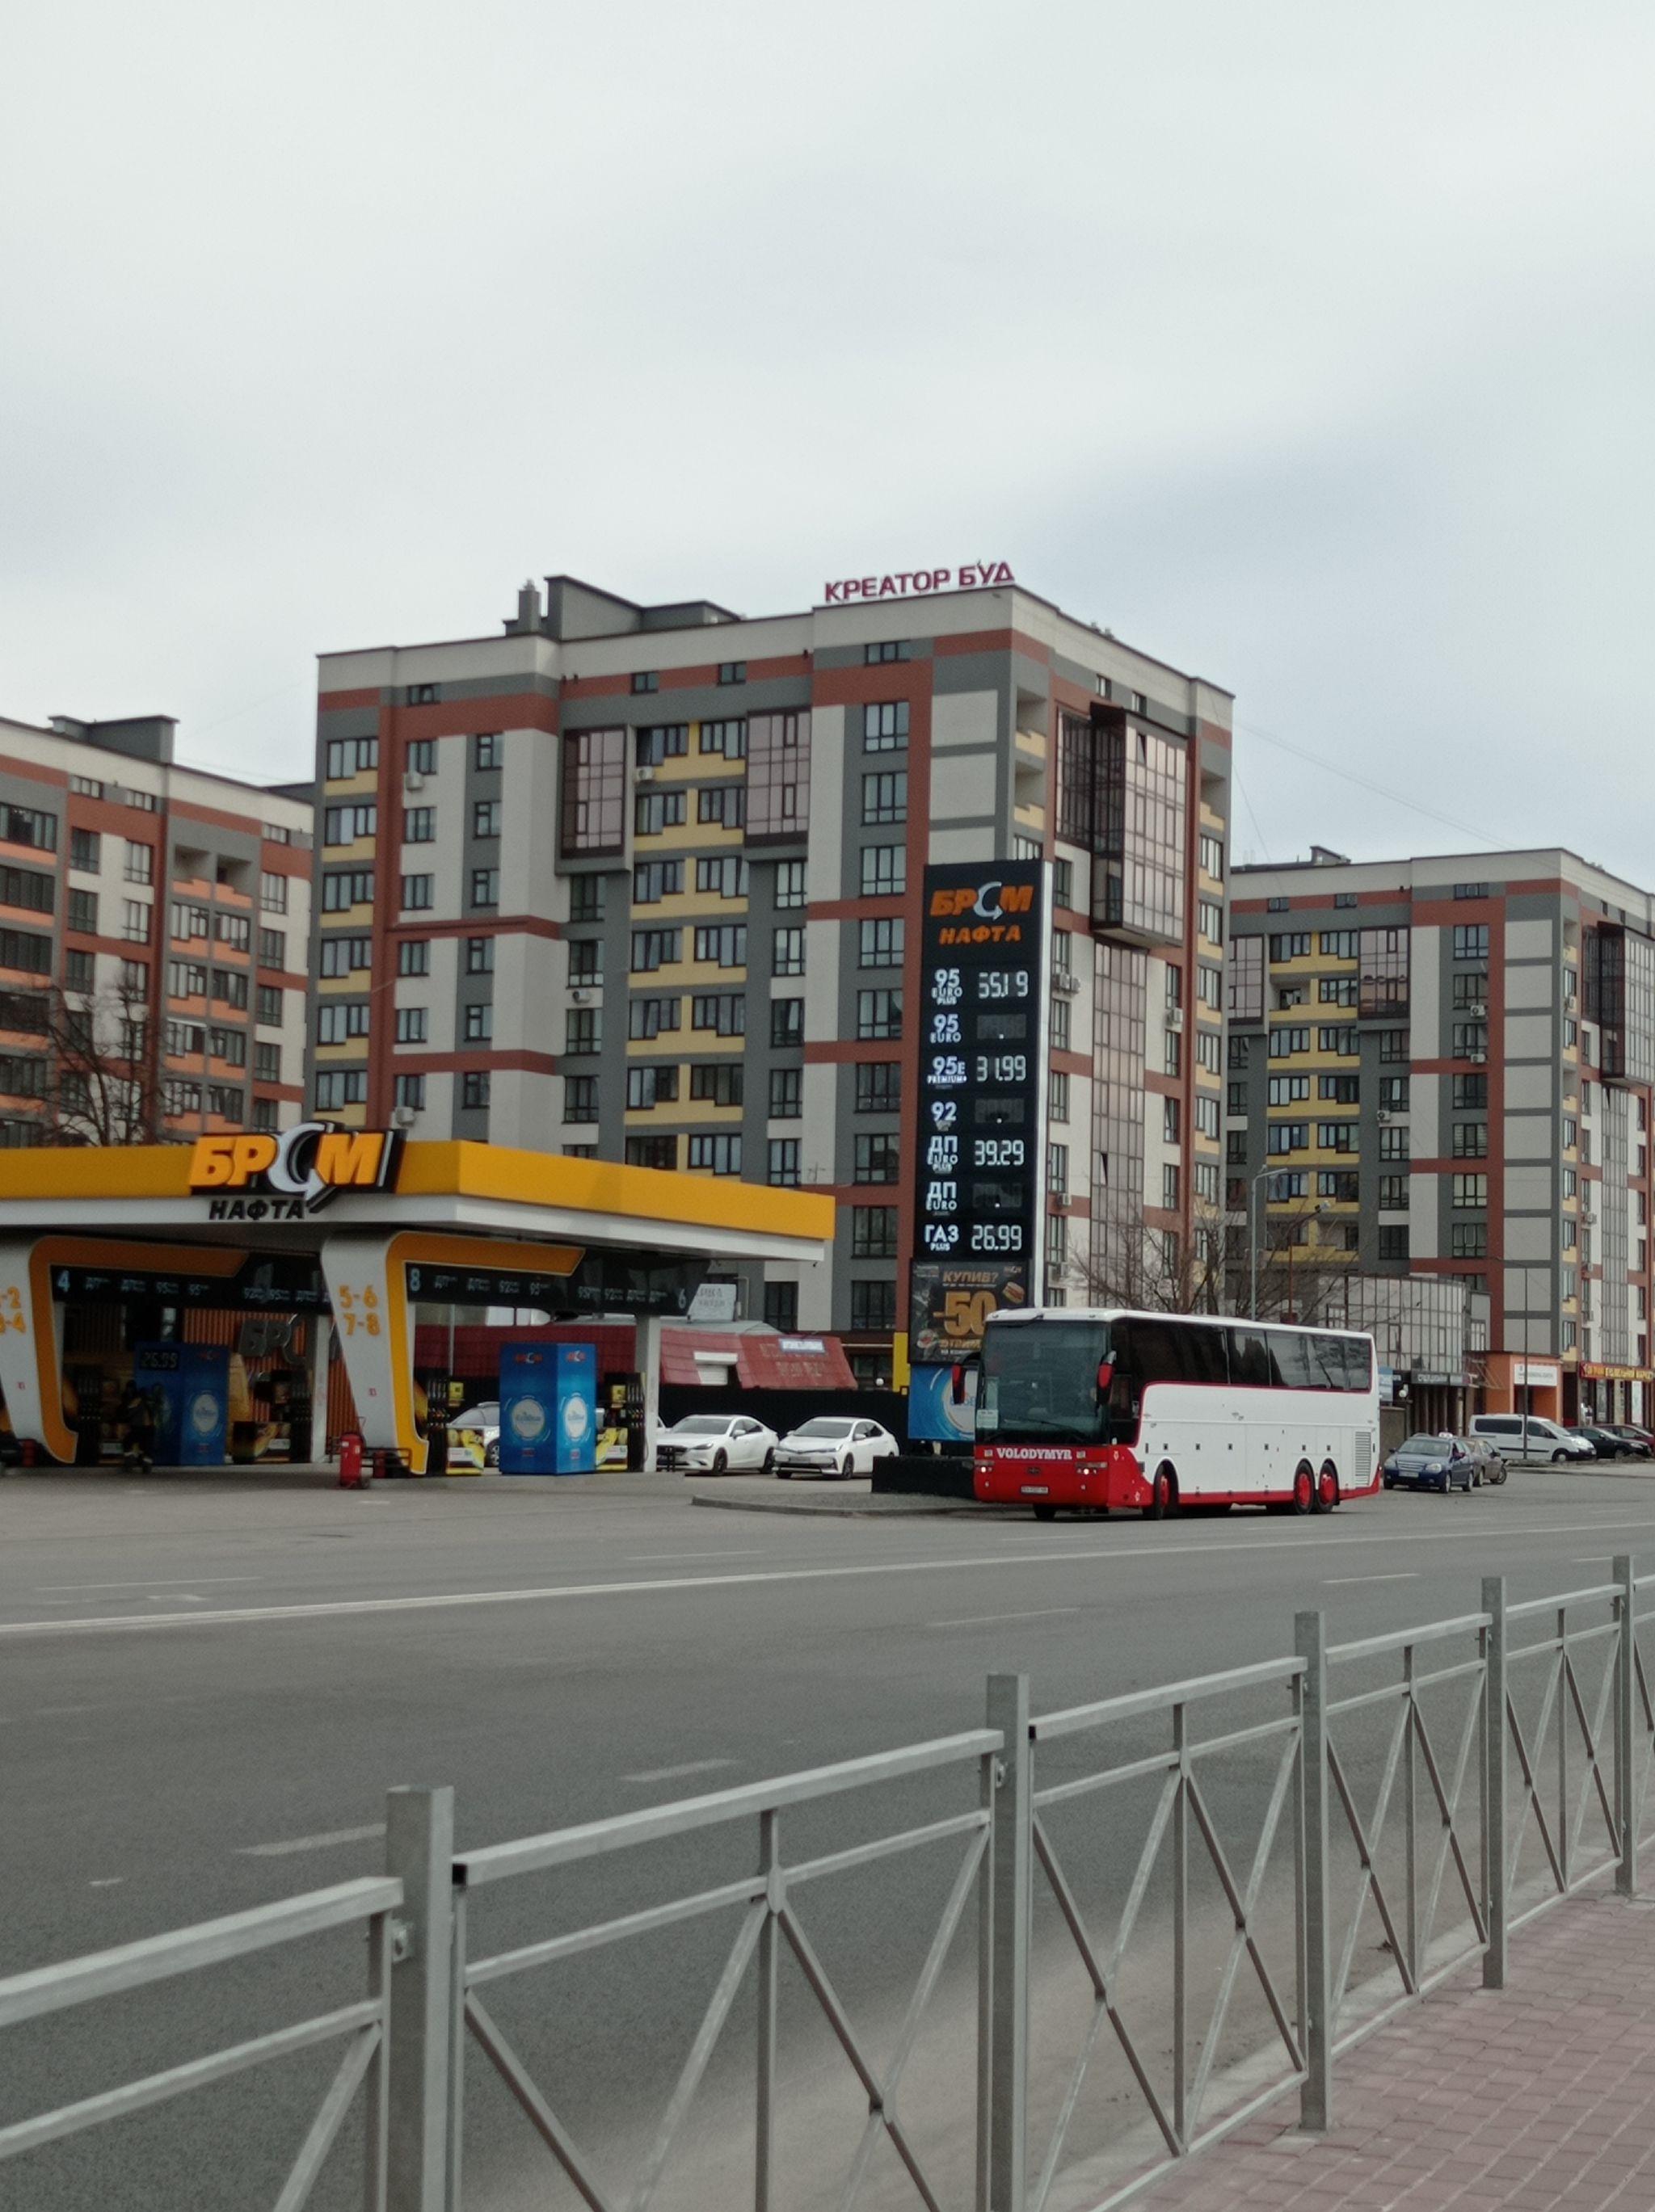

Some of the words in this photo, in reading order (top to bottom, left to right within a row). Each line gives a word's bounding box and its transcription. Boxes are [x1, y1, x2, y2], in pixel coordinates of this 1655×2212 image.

[825, 569, 950, 603] КРЕАТОР
[958, 561, 1015, 587] БУД
[931, 881, 1034, 920] БРСМ
[939, 925, 1021, 944] НАФТА
[934, 969, 960, 989] 95
[931, 987, 963, 999] EURO
[933, 1014, 959, 1034] 95
[930, 1032, 962, 1043] EURO
[976, 1055, 1026, 1082] 31.99
[931, 1102, 957, 1121] 92
[927, 1153, 958, 1166] EURO
[929, 1135, 958, 1154] ДП
[974, 1139, 1025, 1166] 39.29
[189, 1122, 387, 1201] БРСМ
[929, 1182, 957, 1201] ДП
[208, 1199, 305, 1221] НАФТА
[926, 1198, 958, 1211] EURO
[924, 1224, 959, 1243] ГАЗ
[971, 1225, 1022, 1251] 26.99
[930, 1243, 950, 1251] PLUS
[57, 1270, 70, 1293] 4
[410, 1268, 420, 1292] 8
[942, 1271, 1000, 1283] КУПИВ?
[0, 1286, 21, 1309] -2
[339, 1283, 377, 1309] 5-6
[678, 1288, 686, 1309] 6
[343, 1312, 380, 1336] 7-8
[996, 1447, 1073, 1461] VOLODYMYR
